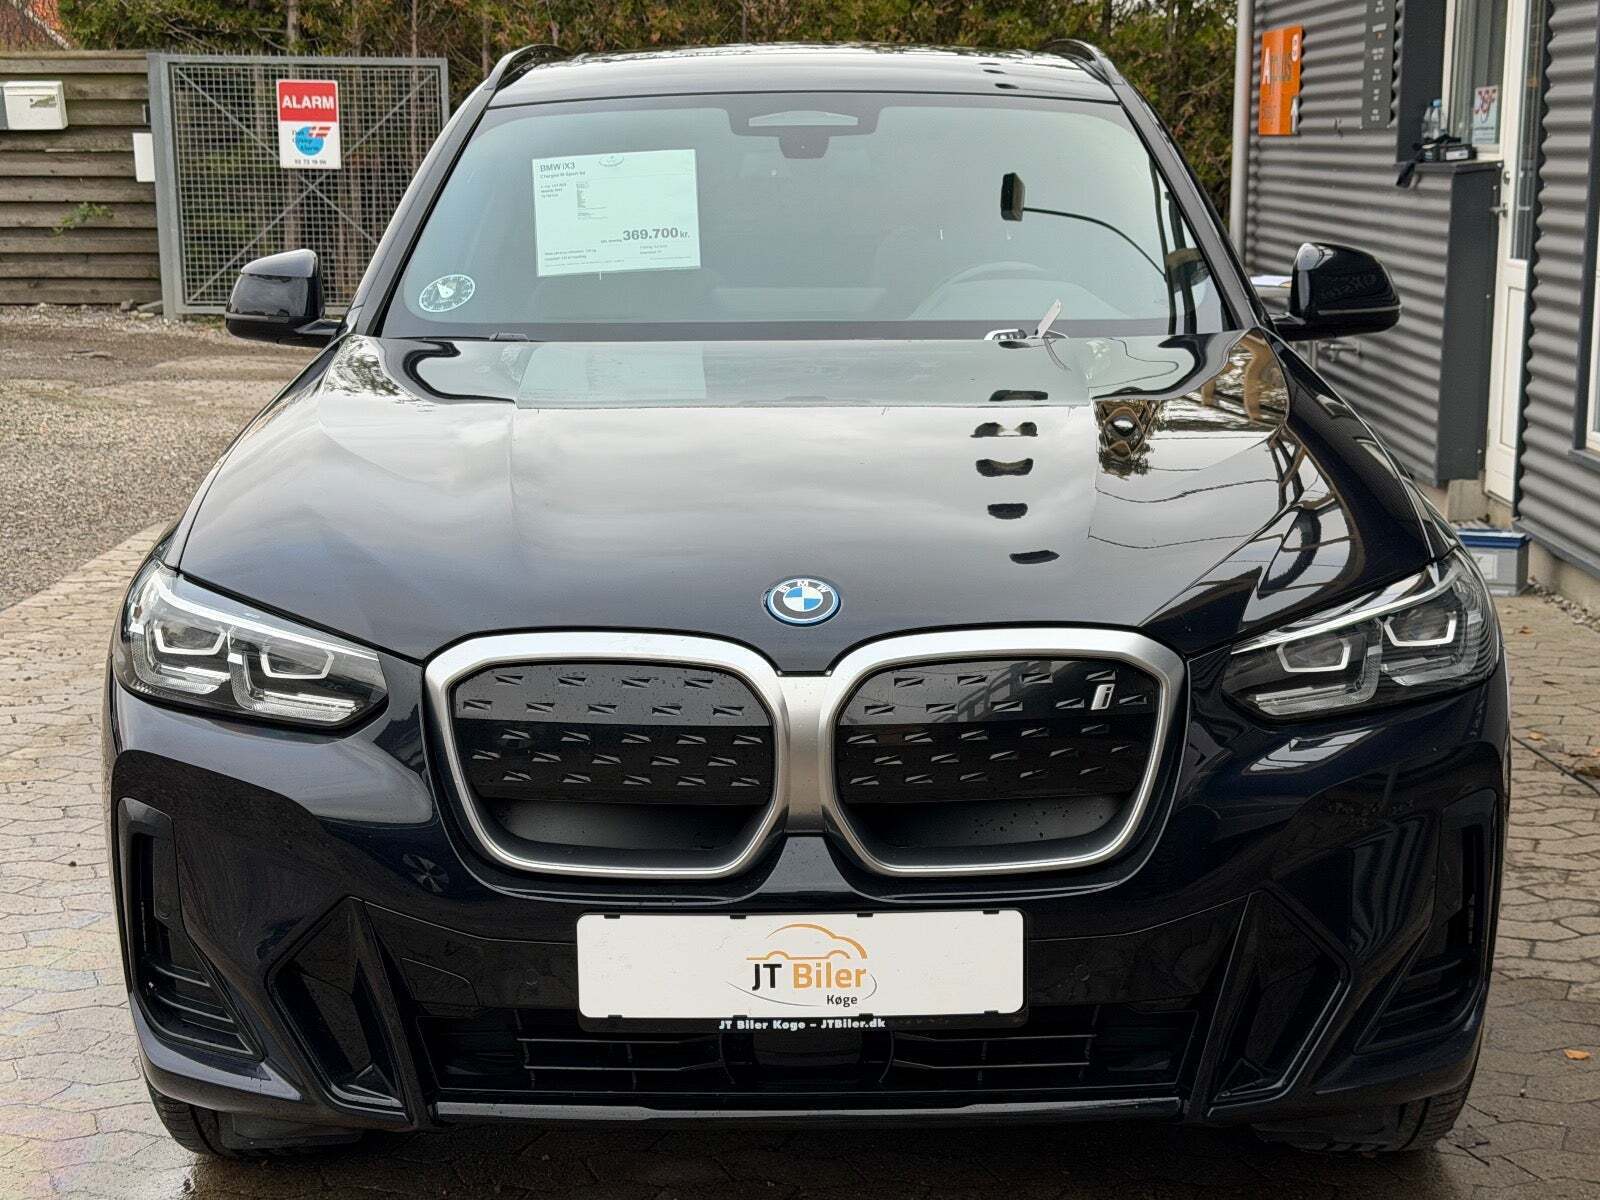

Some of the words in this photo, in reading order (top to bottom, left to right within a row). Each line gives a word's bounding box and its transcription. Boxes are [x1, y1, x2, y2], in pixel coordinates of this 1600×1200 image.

[282, 94, 334, 109] ALARM
[540, 163, 561, 172] BMW
[562, 161, 575, 170] iX3
[623, 227, 679, 241] 369.700
[680, 227, 690, 238] kr.
[777, 579, 831, 593] BMW
[752, 963, 782, 991] JT
[793, 961, 867, 989] Biler
[827, 994, 858, 1007] Køge
[719, 1020, 732, 1030] JT
[736, 1019, 768, 1030] Biler
[820, 1018, 886, 1029] JTBiler.dk
